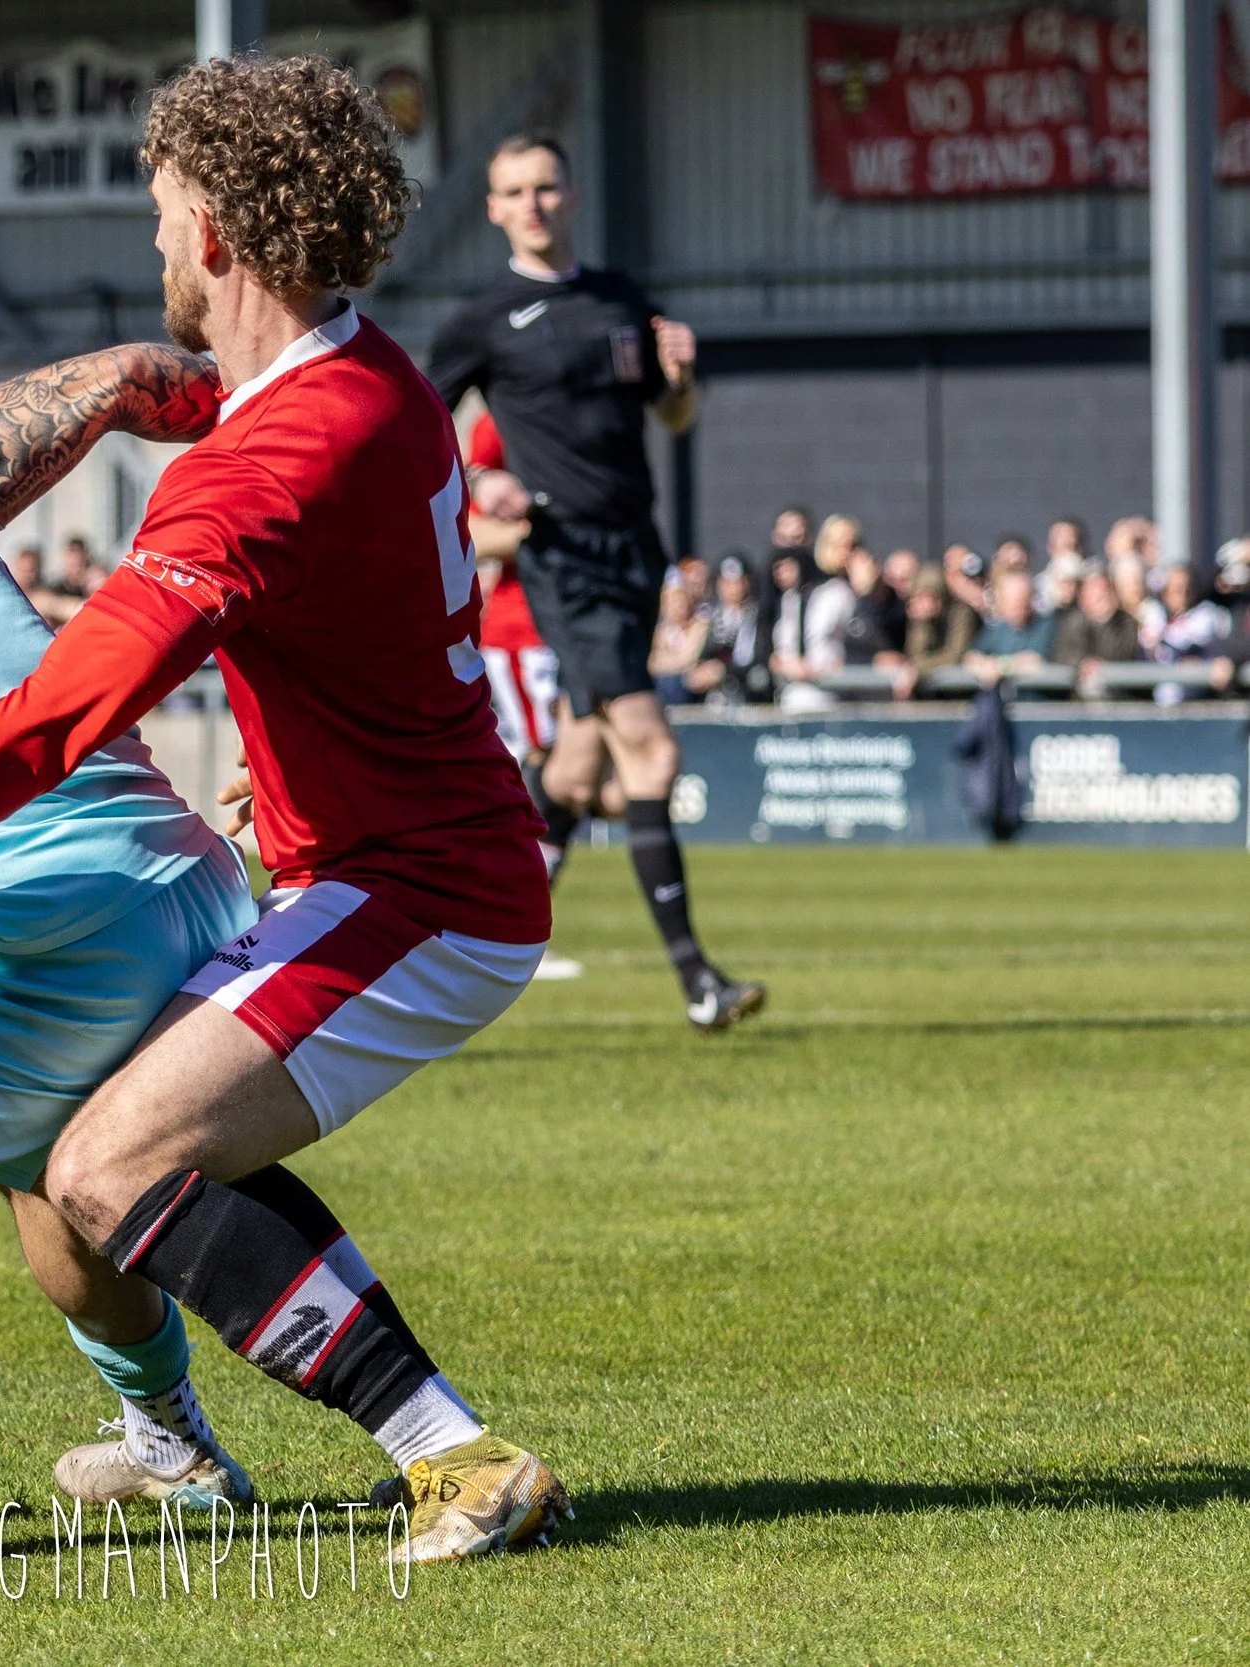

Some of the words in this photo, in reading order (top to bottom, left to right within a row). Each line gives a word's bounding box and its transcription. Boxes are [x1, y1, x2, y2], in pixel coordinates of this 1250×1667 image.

[904, 76, 974, 137] NO
[848, 137, 916, 194] WE
[927, 131, 1055, 194] STAND
[176, 562, 213, 582] PARTNERS
